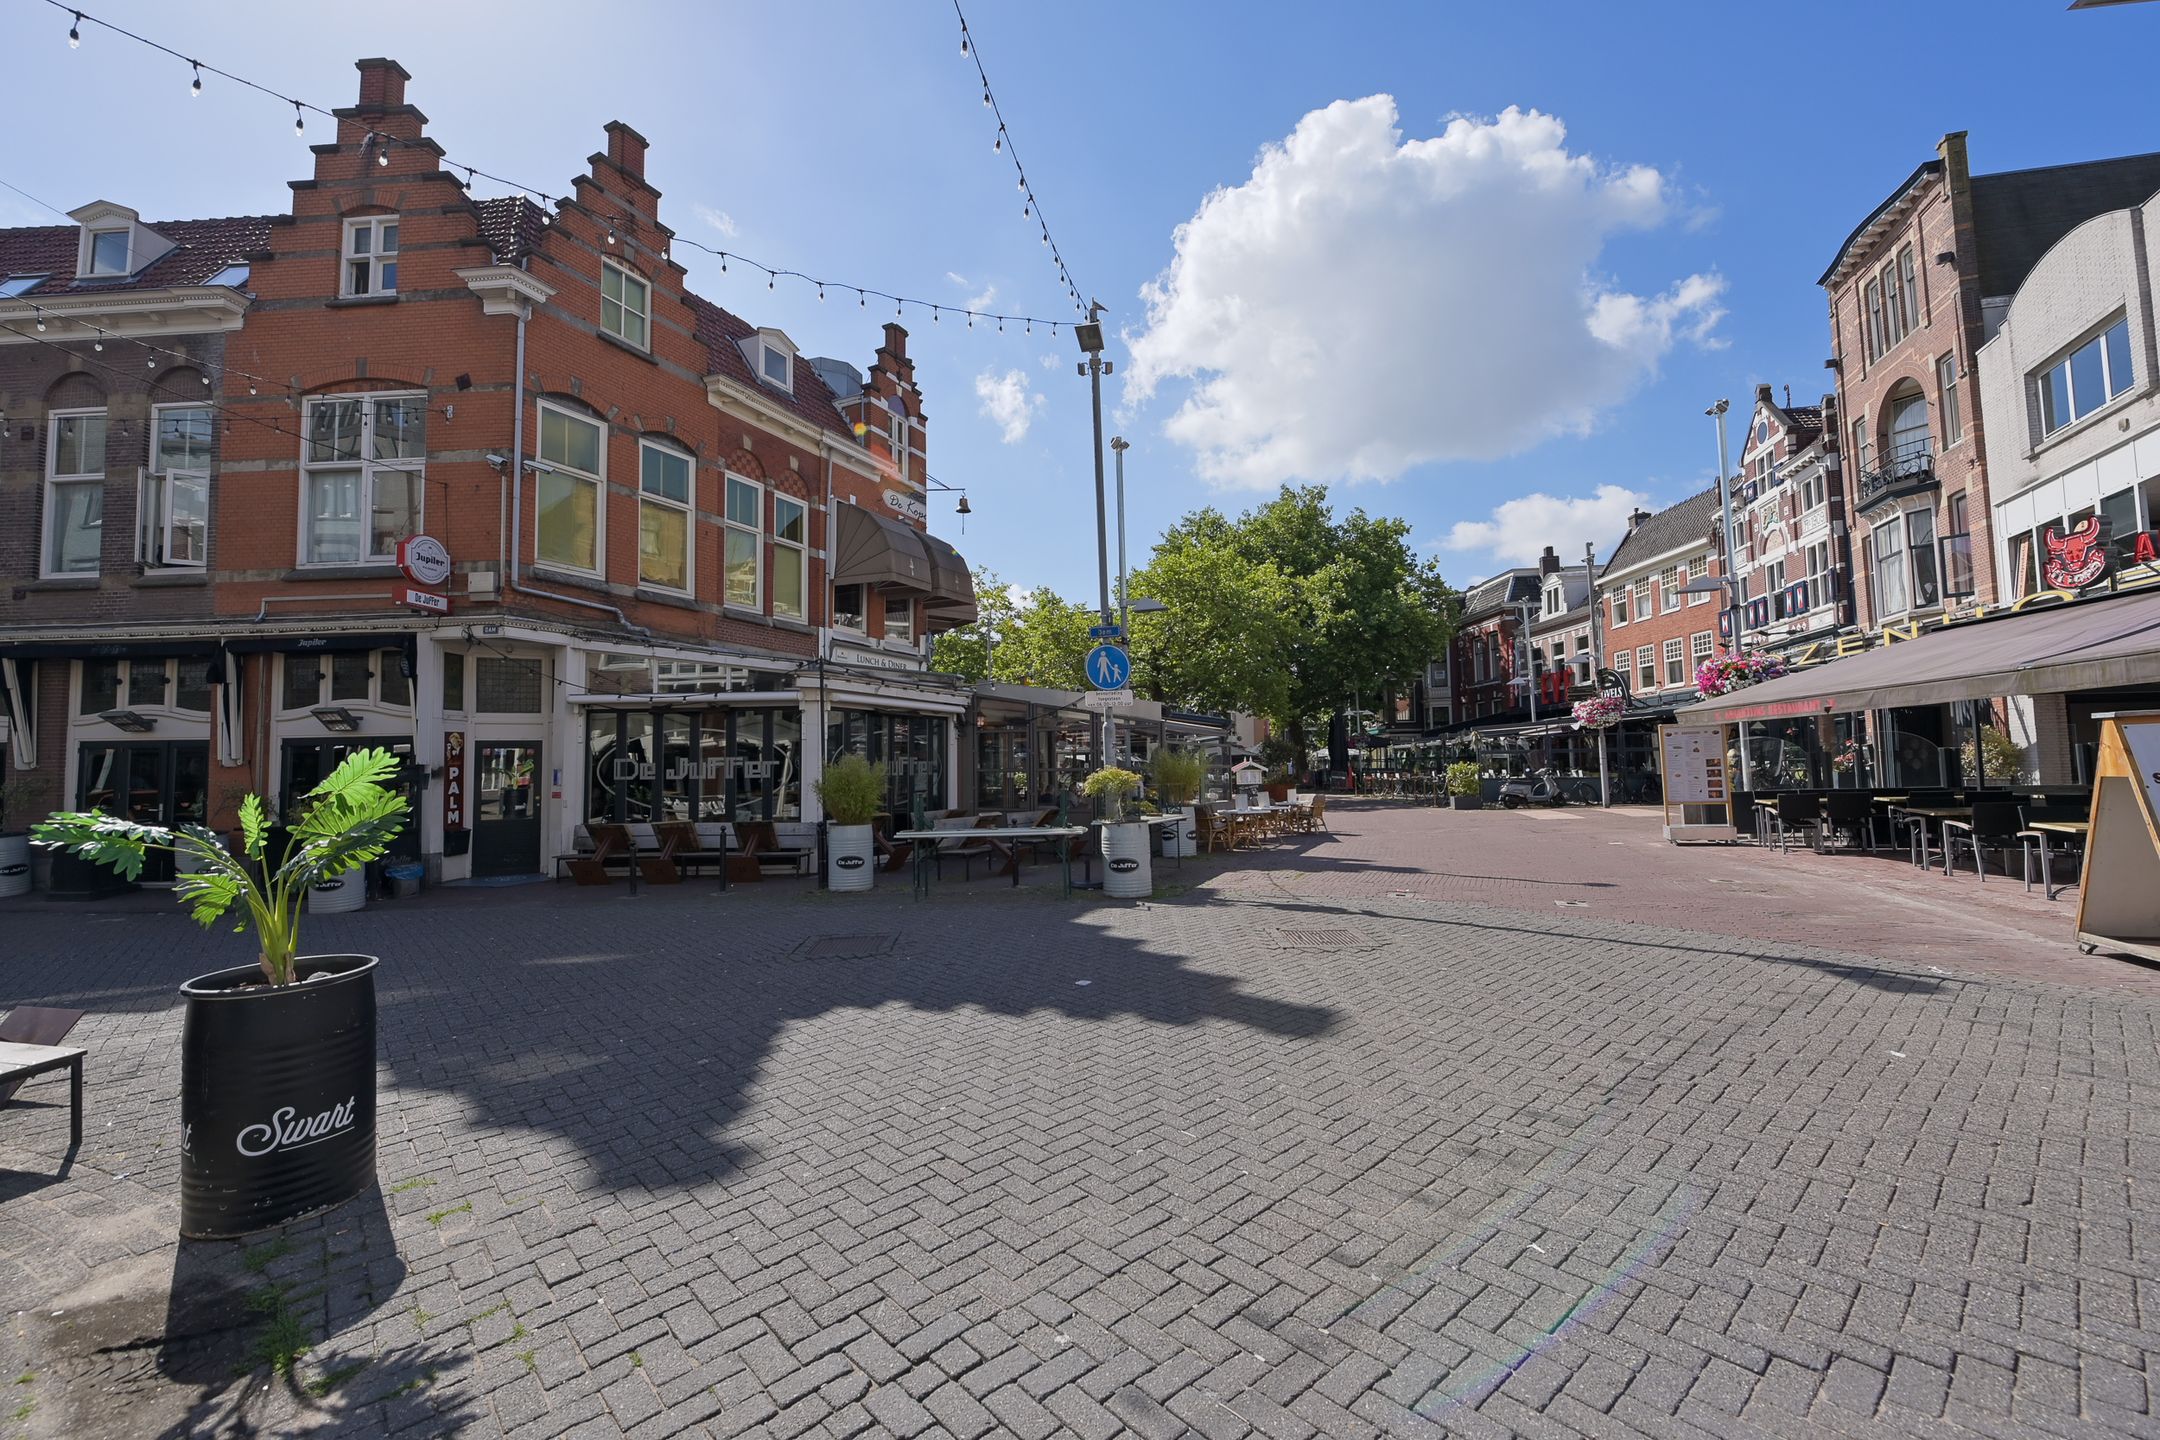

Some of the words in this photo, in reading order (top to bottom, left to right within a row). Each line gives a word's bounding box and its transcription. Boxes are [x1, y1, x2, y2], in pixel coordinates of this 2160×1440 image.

[416, 552, 445, 567] Jupiler
[415, 593, 422, 603] De
[423, 595, 440, 607] Juffer
[299, 638, 327, 647] Jupiler
[857, 654, 879, 666] LUNCH
[881, 658, 887, 668] &
[1767, 699, 1820, 716] RESTAURANT
[613, 758, 656, 780] De
[665, 757, 780, 780] Juffer
[447, 767, 460, 824] PALM
[236, 1096, 355, 1156] Swart
